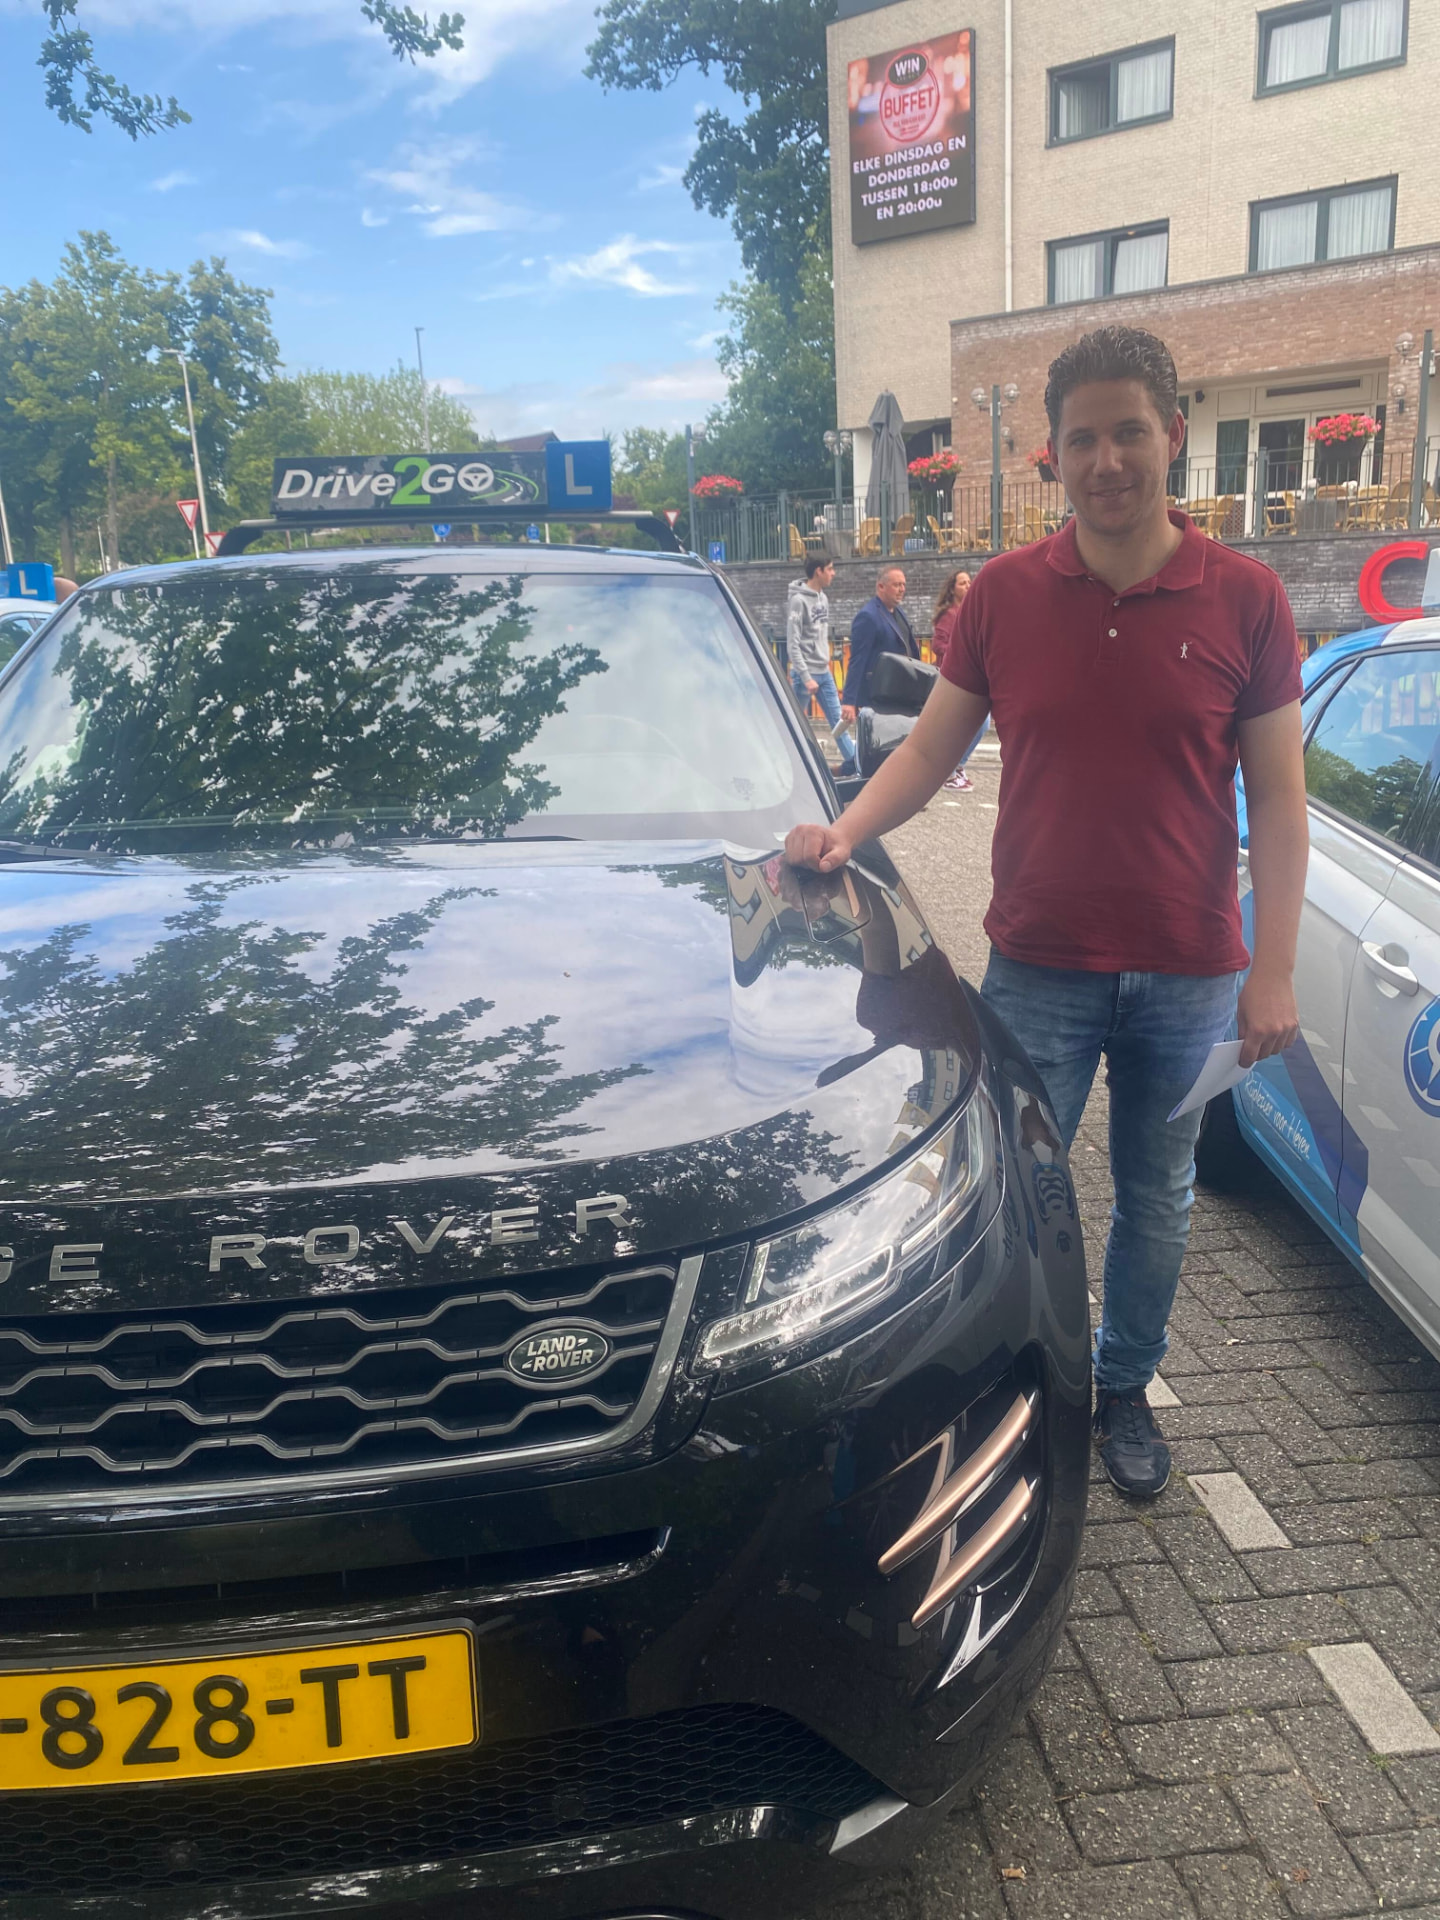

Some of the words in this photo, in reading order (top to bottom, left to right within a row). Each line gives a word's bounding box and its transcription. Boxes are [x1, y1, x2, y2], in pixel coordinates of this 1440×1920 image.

[884, 86, 935, 119] BUFFET
[852, 156, 882, 174] ELKE
[884, 141, 944, 166] DINSDAG
[947, 134, 967, 151] EN
[868, 157, 951, 188] DONDERDAG
[861, 185, 909, 206] TUSSEN
[913, 176, 958, 195] 18:00u
[876, 205, 894, 221] EN
[897, 197, 943, 216] 20:00u
[564, 453, 593, 495] L
[18, 570, 38, 595] L
[208, 1194, 632, 1272] ROVER
[527, 1335, 577, 1357] LAND
[532, 1349, 594, 1372] ROVER
